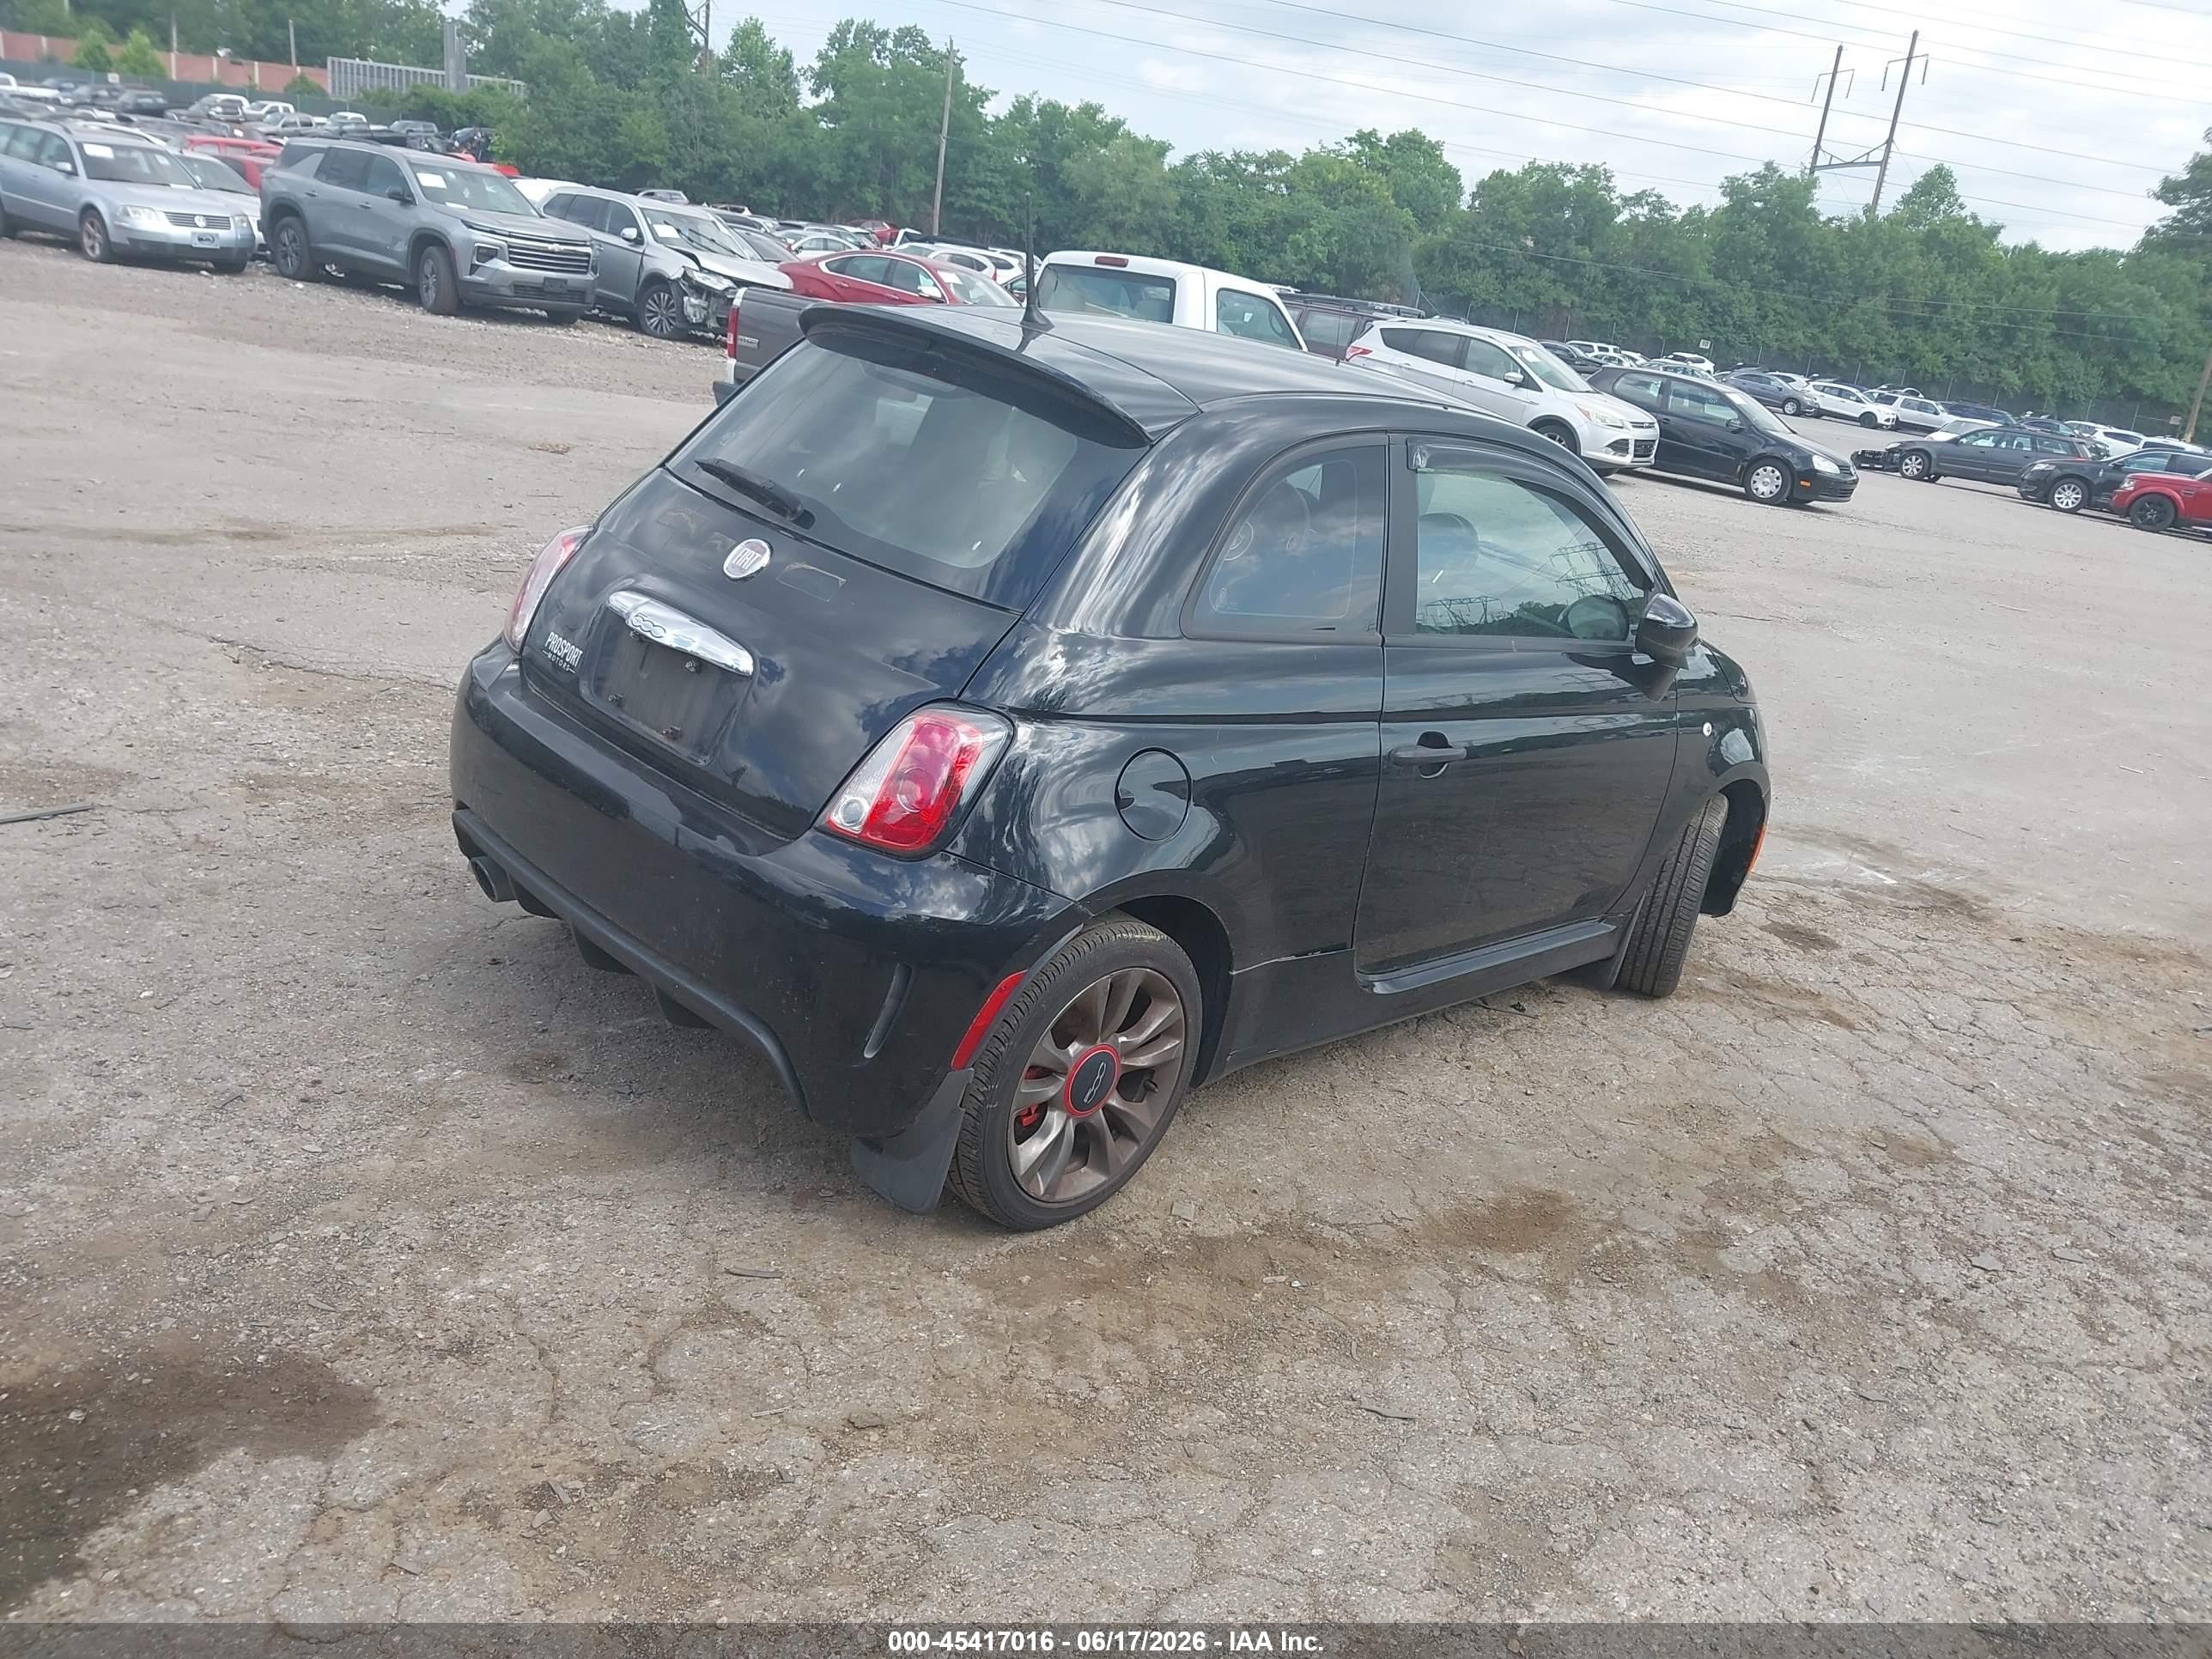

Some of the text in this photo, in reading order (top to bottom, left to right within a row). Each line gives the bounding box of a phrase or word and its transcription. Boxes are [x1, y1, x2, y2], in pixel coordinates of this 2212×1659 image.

[732, 548, 762, 570] FIAT
[544, 631, 583, 667] PROSPORT
[547, 651, 570, 672] MOTORS
